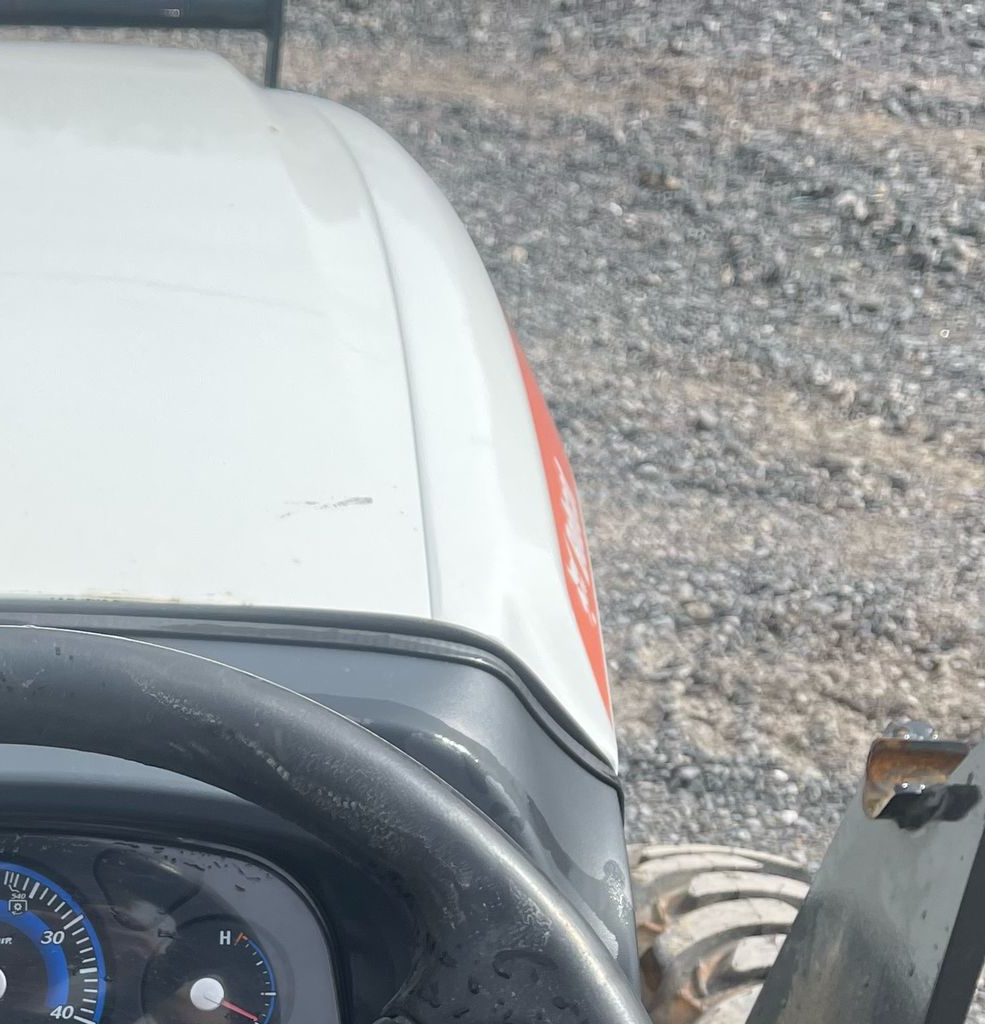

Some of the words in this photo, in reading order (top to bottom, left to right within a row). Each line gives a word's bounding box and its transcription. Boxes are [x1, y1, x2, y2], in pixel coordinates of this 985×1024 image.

[41, 931, 65, 944] 30
[219, 930, 231, 945] H
[50, 1005, 74, 1019] 40
